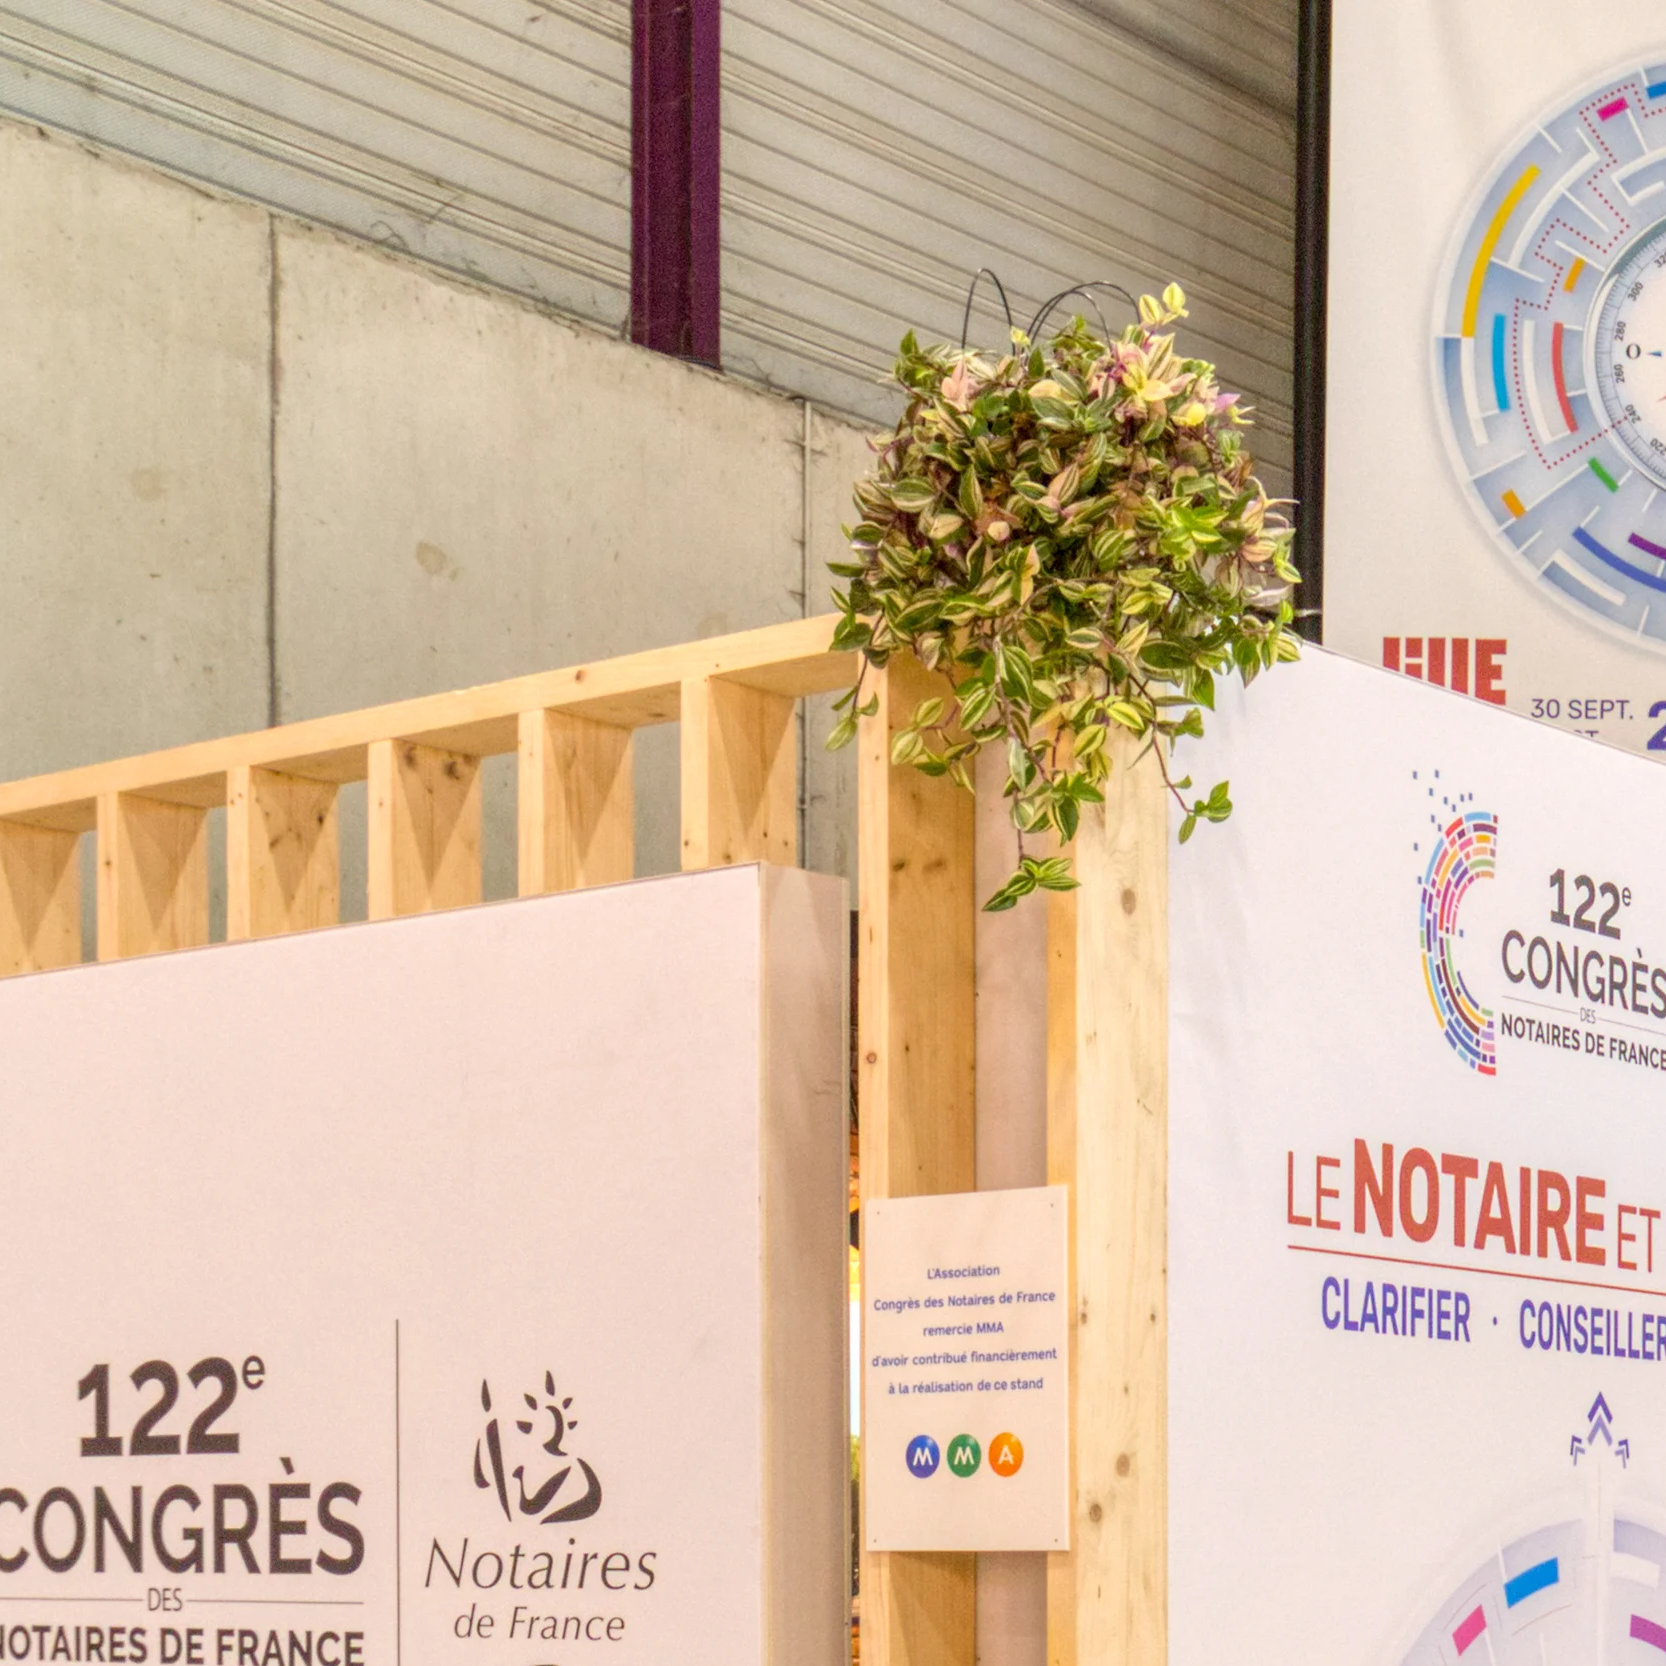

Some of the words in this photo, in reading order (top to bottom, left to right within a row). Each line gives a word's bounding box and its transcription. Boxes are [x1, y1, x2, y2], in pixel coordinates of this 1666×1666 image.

[1628, 282, 1644, 301] 300
[1614, 321, 1627, 341] 280
[1626, 344, 1641, 360] O
[1615, 364, 1624, 383] 260
[1625, 404, 1642, 425] 240
[1531, 697, 1561, 720] 30
[1567, 699, 1634, 721] SEPT.
[1580, 1007, 1596, 1024] DES
[1501, 1013, 1581, 1051] NOTAIRES
[1585, 1032, 1605, 1057] DE
[1287, 1150, 1341, 1231] LE
[1353, 1137, 1607, 1267] NOTAIRE
[1617, 1204, 1661, 1274] ET
[927, 1264, 1000, 1281] L'Association
[874, 1296, 920, 1313] Congrès
[924, 1295, 943, 1309] des
[948, 1292, 995, 1307] Notaires
[998, 1291, 1013, 1304] de
[1017, 1290, 1055, 1304] France
[1321, 1276, 1471, 1343] CLARIFIER
[923, 1323, 973, 1337] remercie
[976, 1322, 1004, 1335] MMA
[872, 1353, 908, 1367] d'avoir
[912, 1350, 967, 1365] contribué
[970, 1348, 1057, 1363] financièrement
[888, 1381, 896, 1394] à
[899, 1382, 909, 1394] la
[913, 1379, 973, 1394] réalisation
[977, 1378, 991, 1392] de
[994, 1380, 1007, 1392] ce
[1010, 1376, 1044, 1391] stand
[425, 1538, 657, 1593] Notaires
[147, 1588, 183, 1612] DES
[454, 1604, 494, 1641] de
[509, 1606, 626, 1643] France
[160, 1630, 204, 1666] DE
